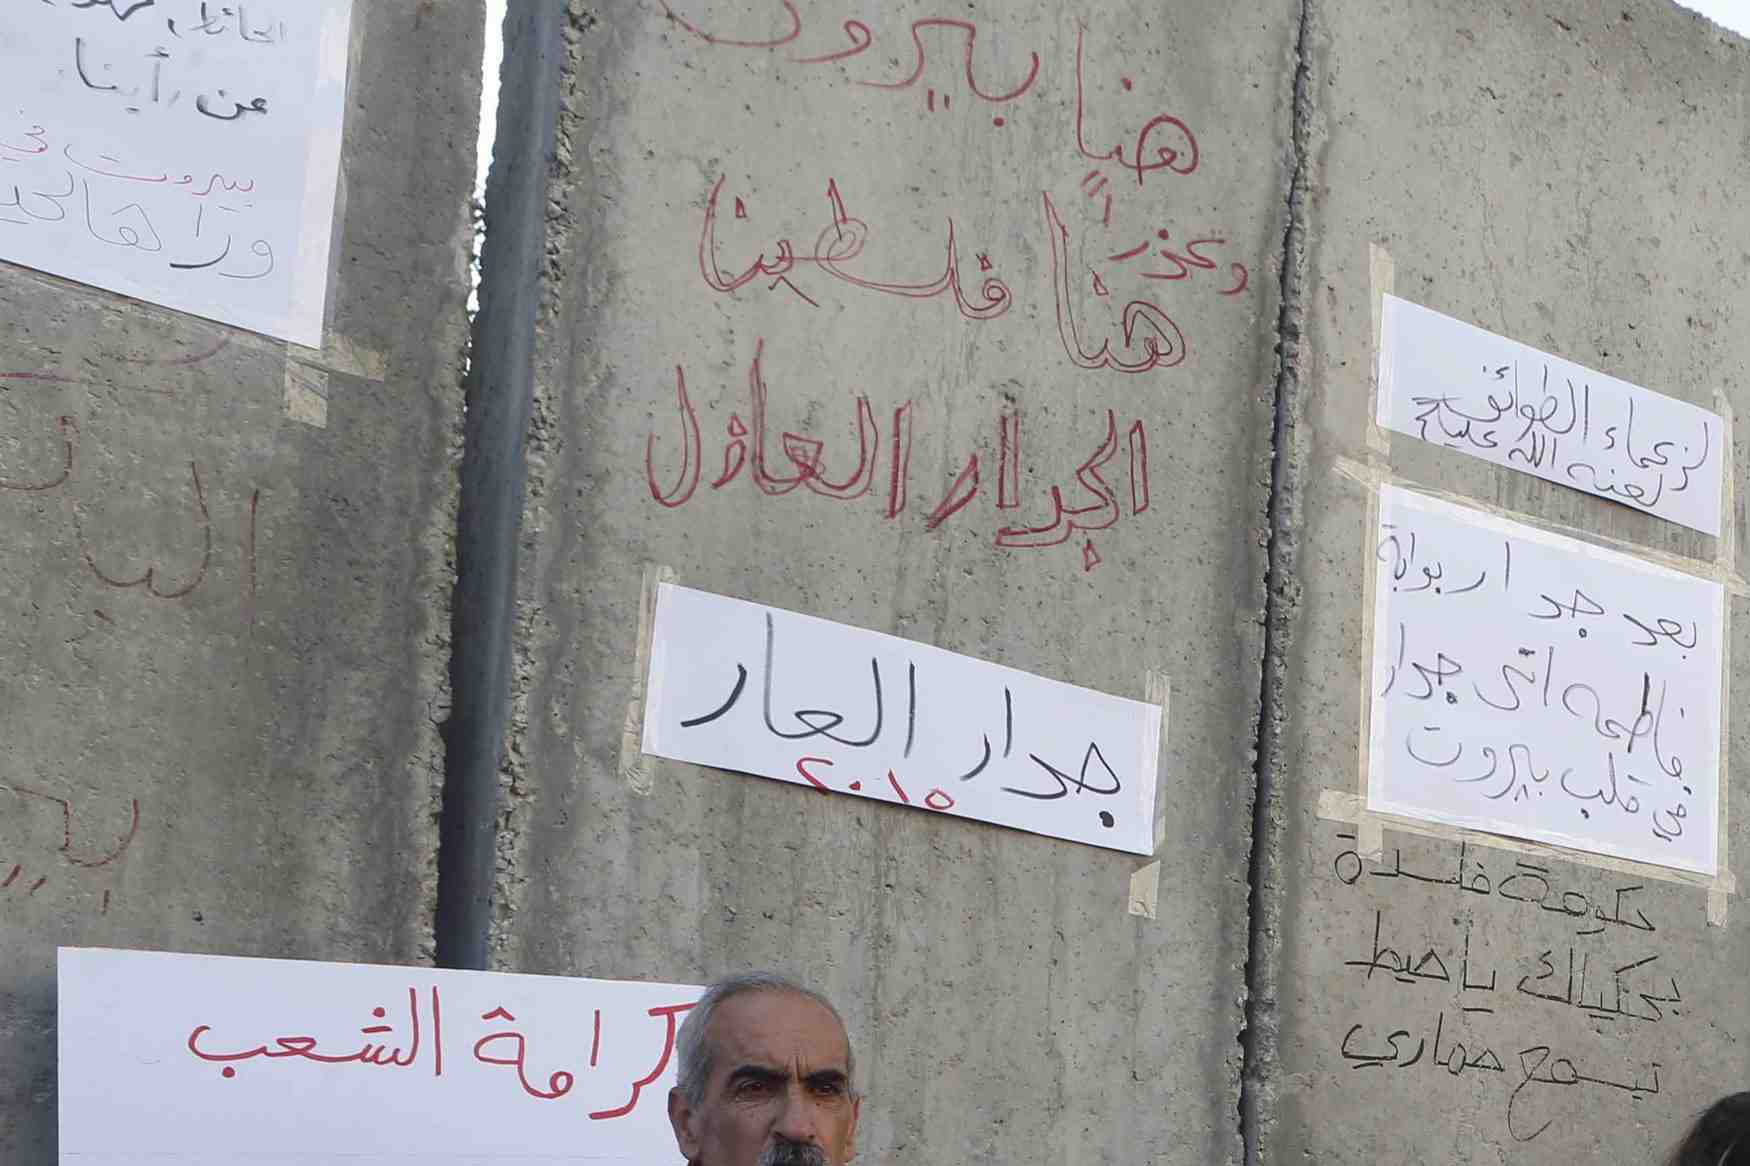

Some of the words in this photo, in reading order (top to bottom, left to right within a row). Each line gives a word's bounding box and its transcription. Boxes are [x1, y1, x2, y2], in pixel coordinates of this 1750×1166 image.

[645, 336, 913, 520] العازل
[929, 405, 1150, 572] الجدار
[1507, 429, 1558, 469] الله
[680, 610, 916, 760] العار
[1622, 612, 1697, 661] بعد
[961, 684, 1122, 828] جدار
[187, 984, 443, 1079] الشعب
[474, 1003, 704, 1121] كرامة
